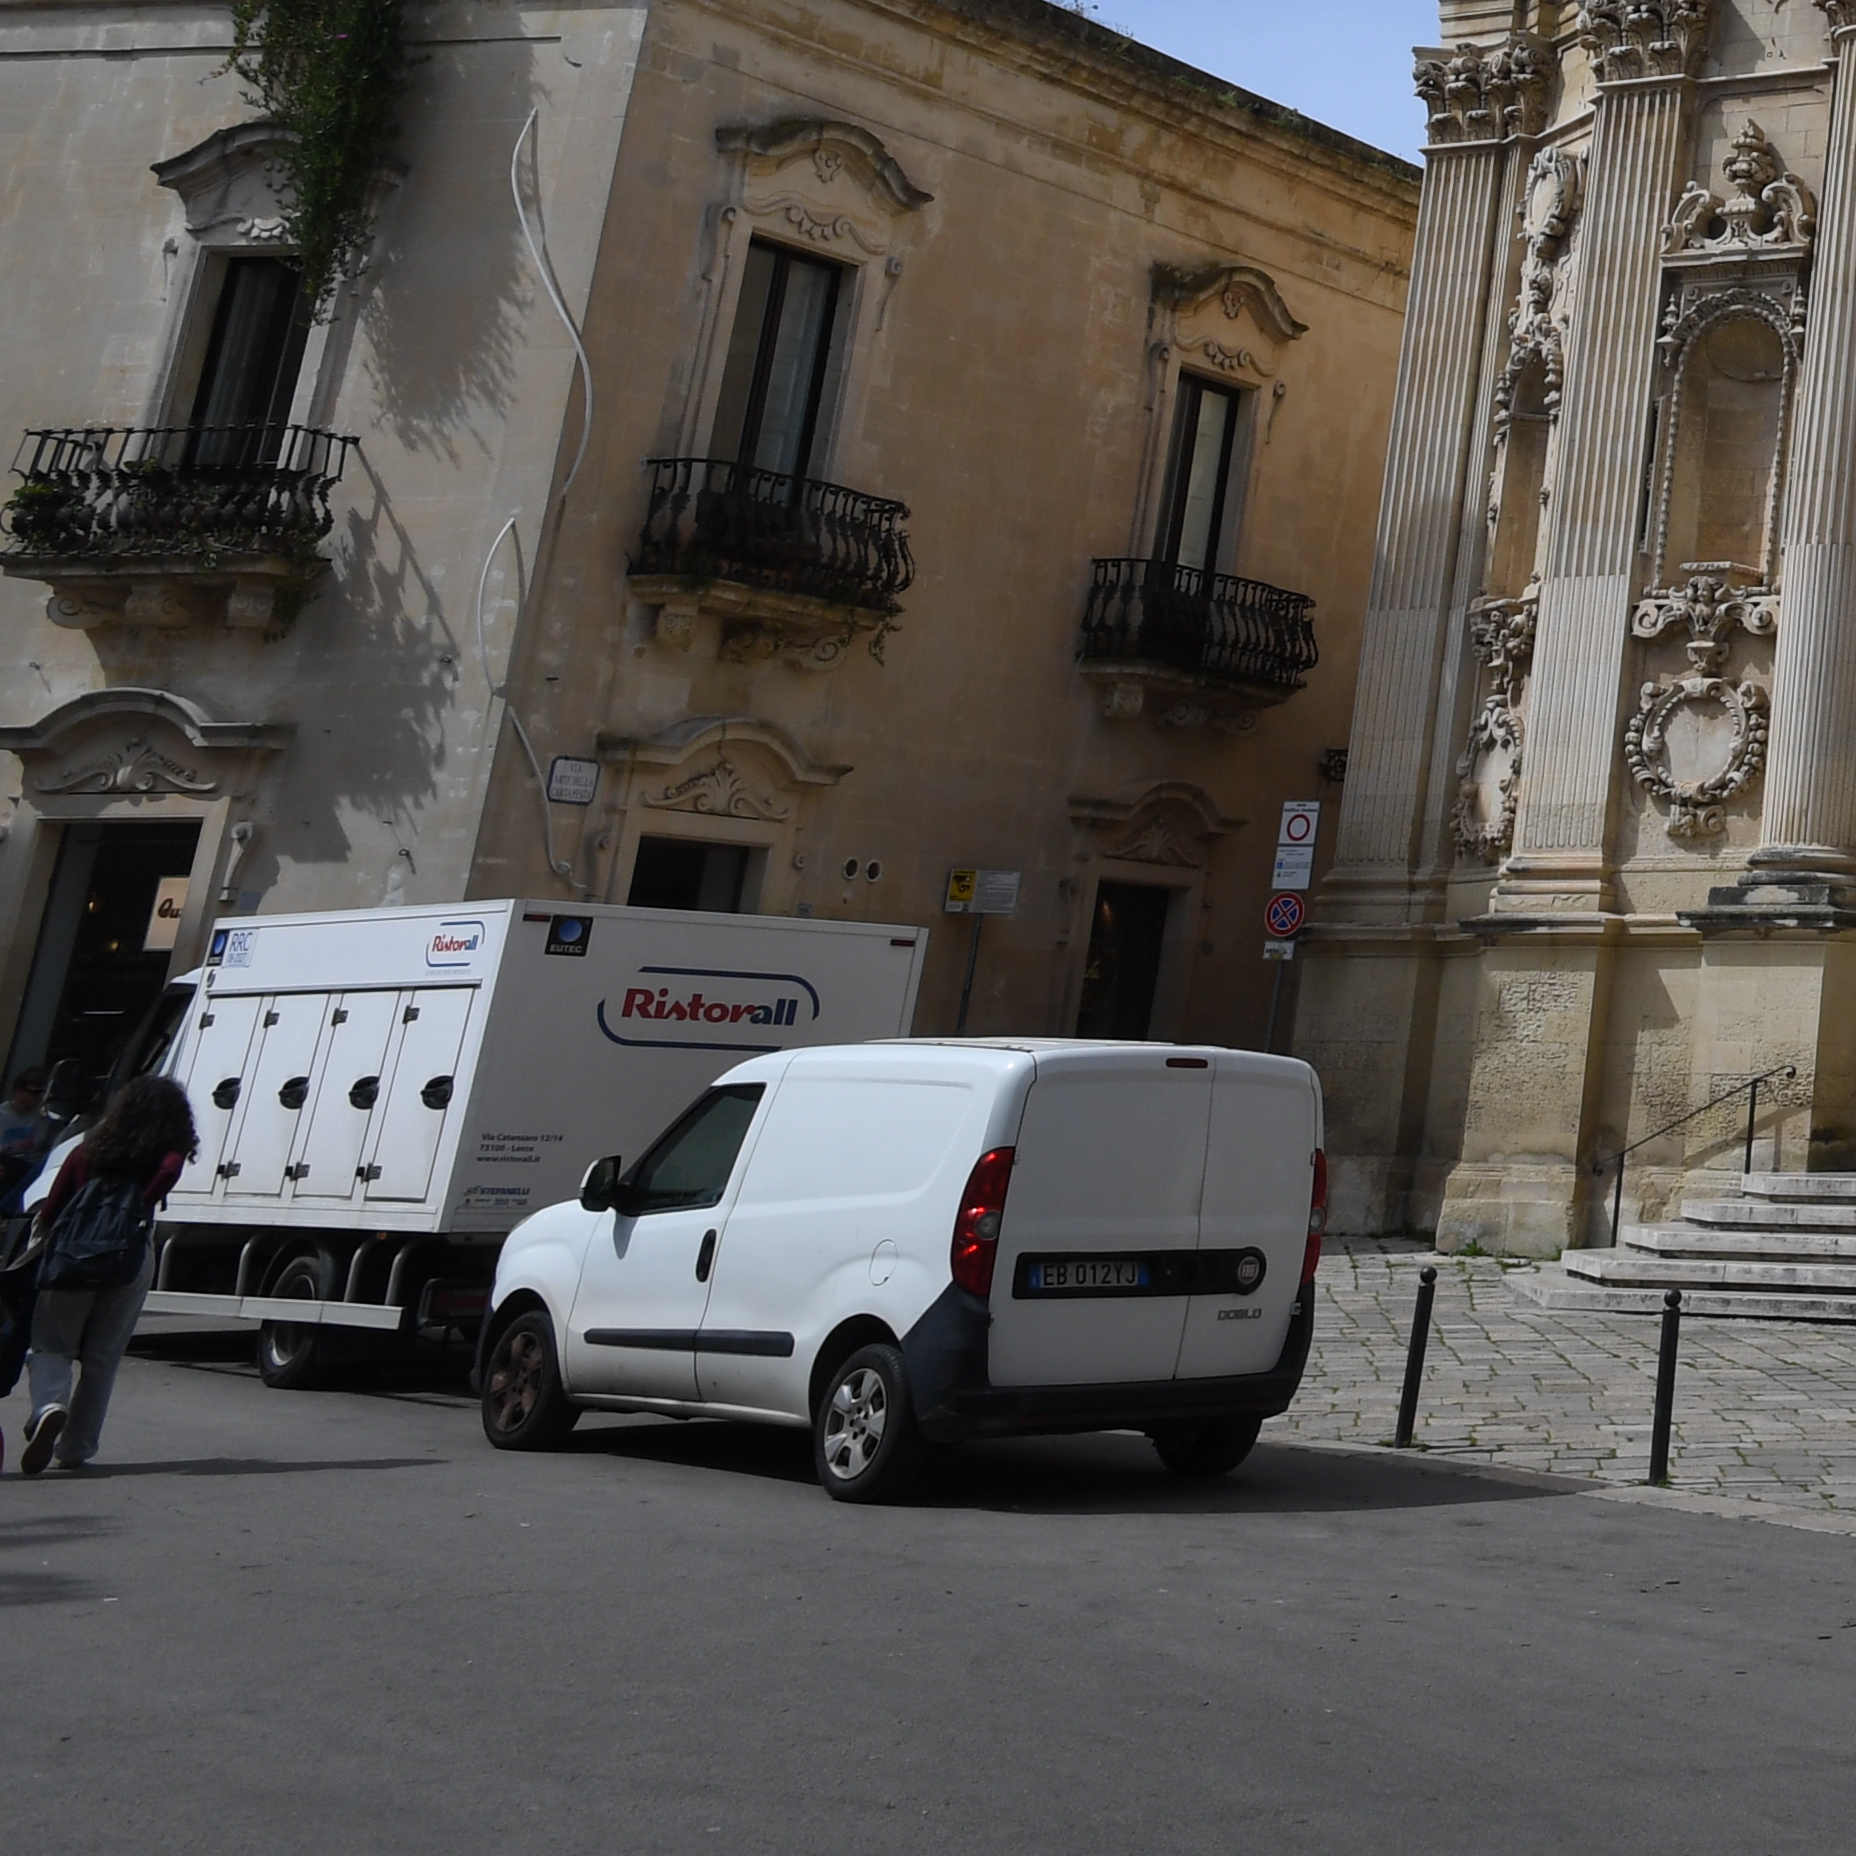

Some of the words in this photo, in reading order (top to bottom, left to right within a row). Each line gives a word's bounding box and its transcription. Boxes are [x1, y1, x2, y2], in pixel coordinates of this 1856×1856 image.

[157, 897, 182, 919] Qu
[431, 934, 479, 953] Ristorall
[550, 944, 583, 954] EUTEC
[621, 987, 799, 1026] Ristorall
[482, 1133, 495, 1141] Via
[497, 1133, 538, 1141] Catanzaro
[476, 1155, 541, 1163] www.ristorall.it
[480, 1187, 531, 1196] STEFANELLI
[1043, 1264, 1068, 1287] EB
[1075, 1263, 1137, 1285] 012YJ
